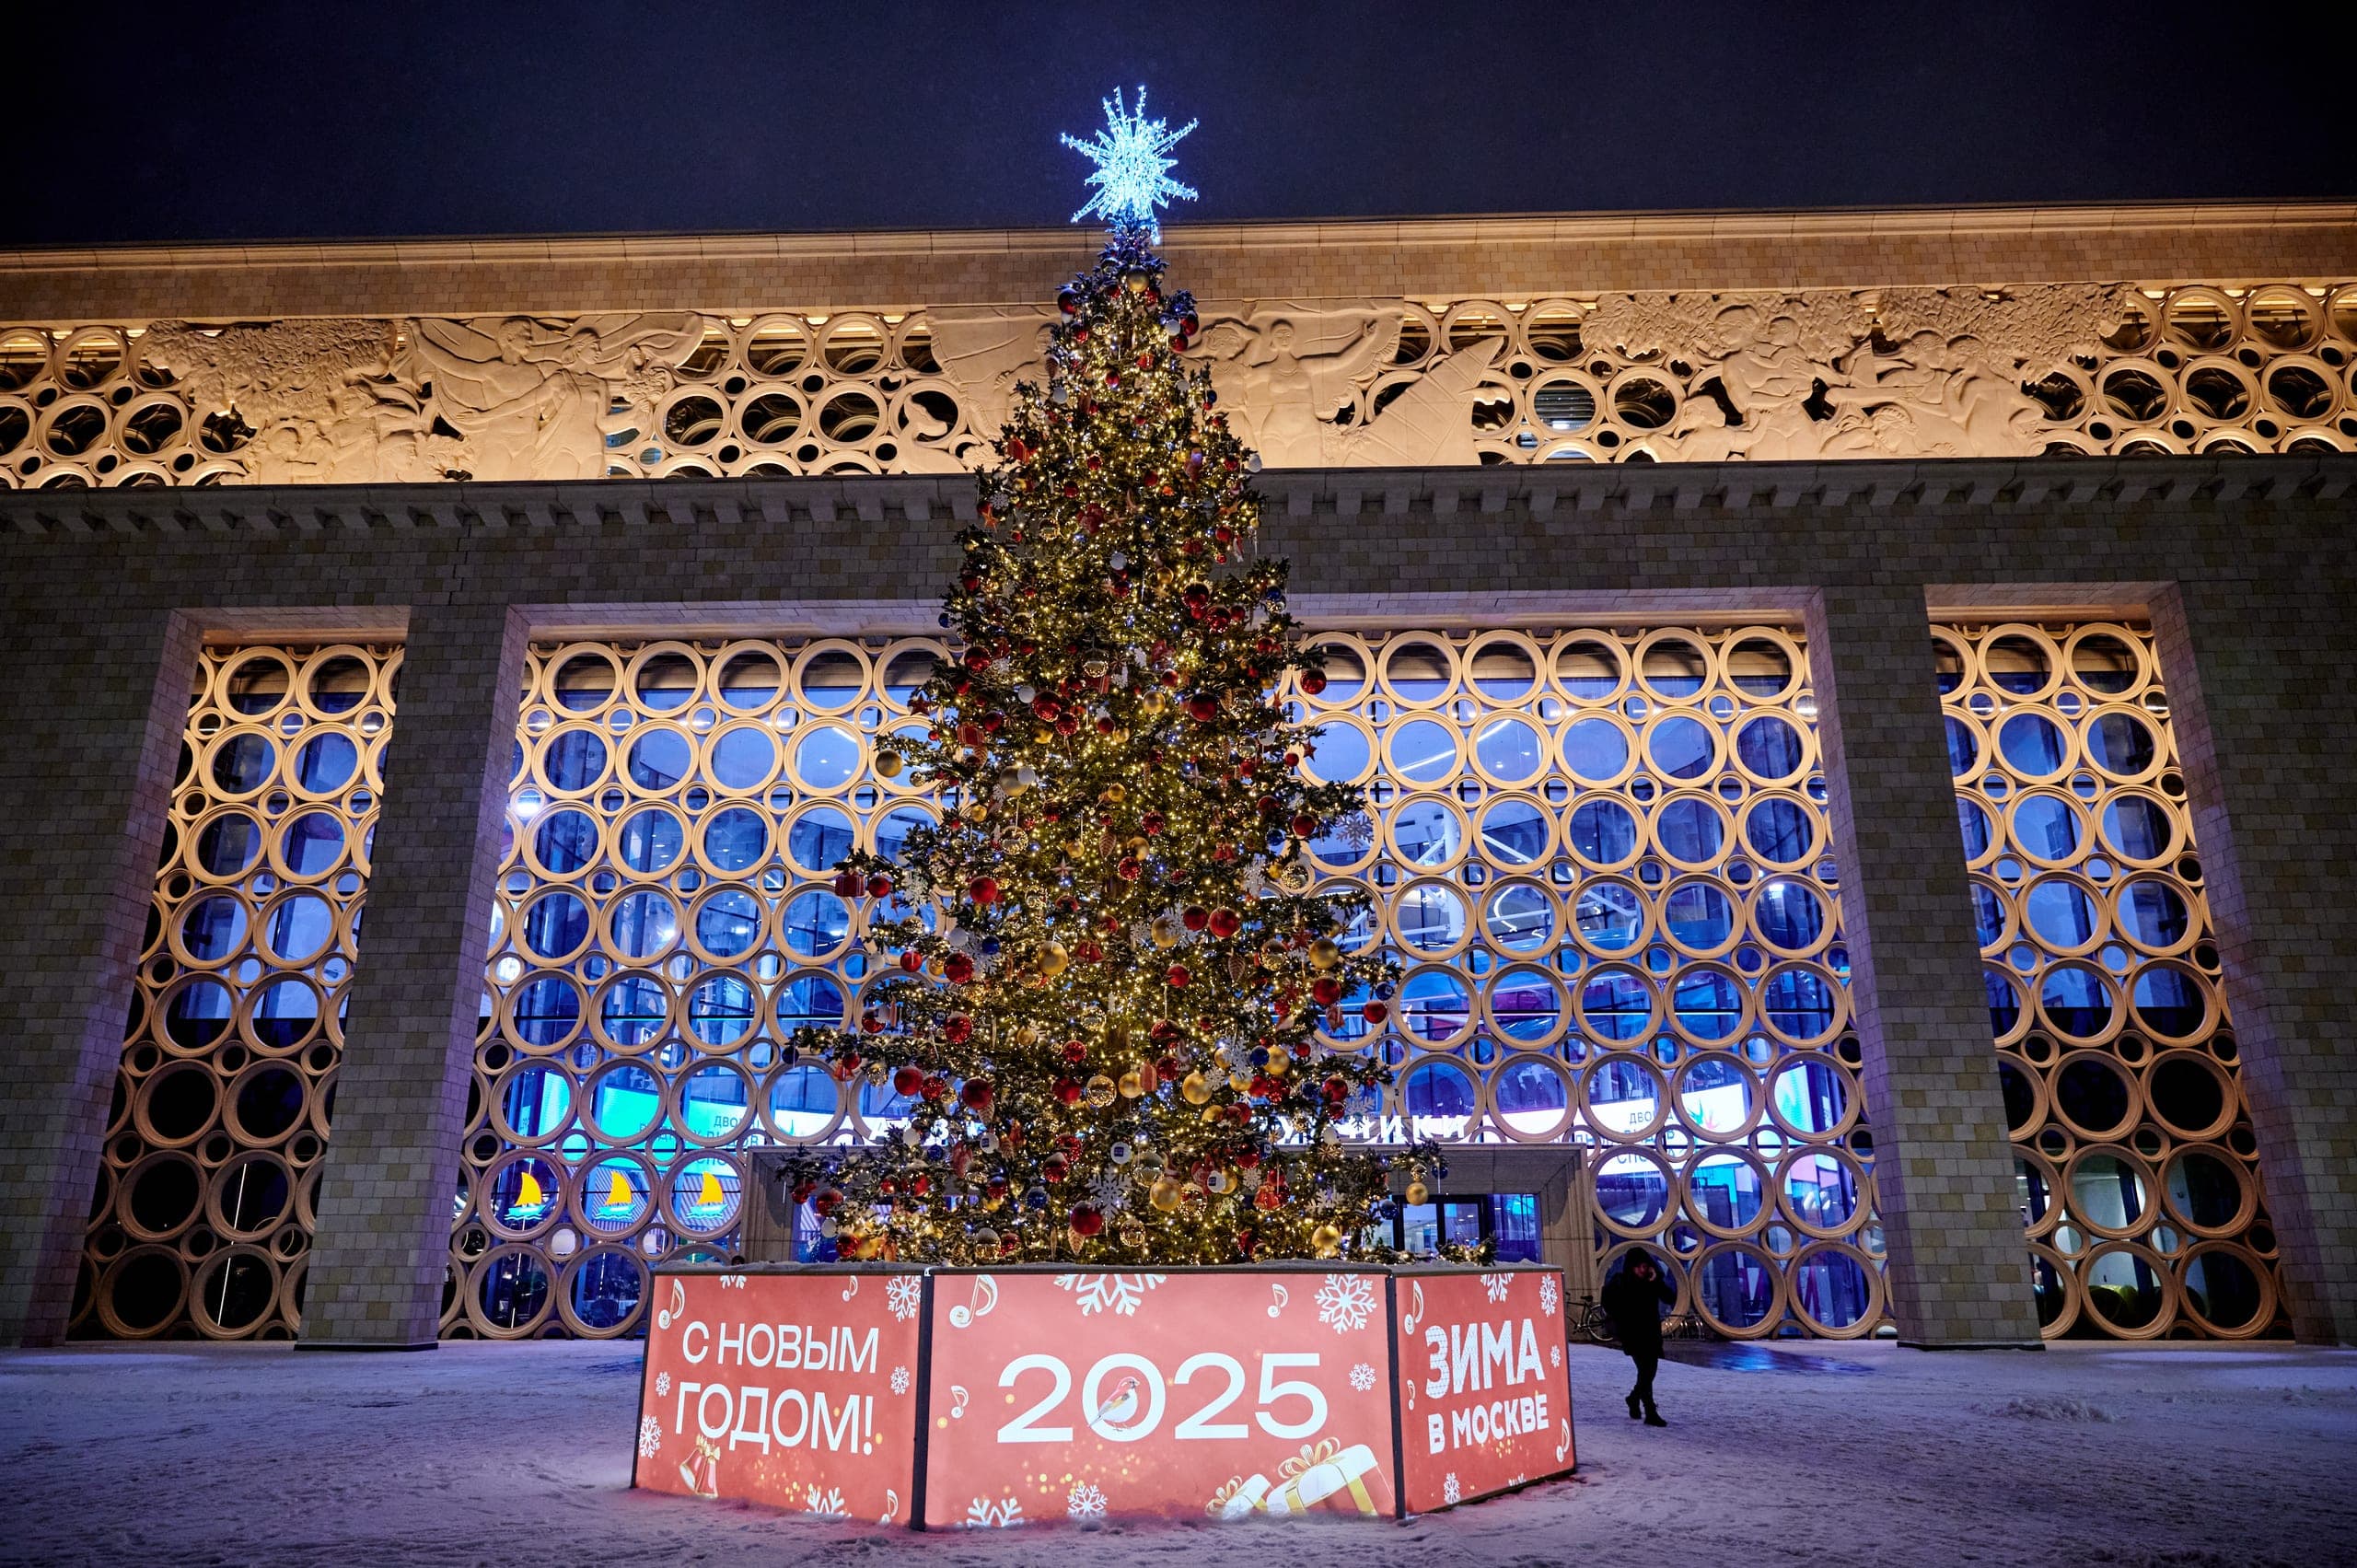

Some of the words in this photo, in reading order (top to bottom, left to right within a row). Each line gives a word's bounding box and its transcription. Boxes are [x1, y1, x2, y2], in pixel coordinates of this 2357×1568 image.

[682, 1320, 710, 1364] С
[717, 1322, 879, 1374] НОВЫМ
[1424, 1318, 1546, 1399] ЗИМА
[675, 1381, 874, 1456] ГОДОМ!
[997, 1353, 1328, 1443] 2025
[1427, 1413, 1446, 1455] В
[1451, 1393, 1550, 1449] МОСКВЕ
